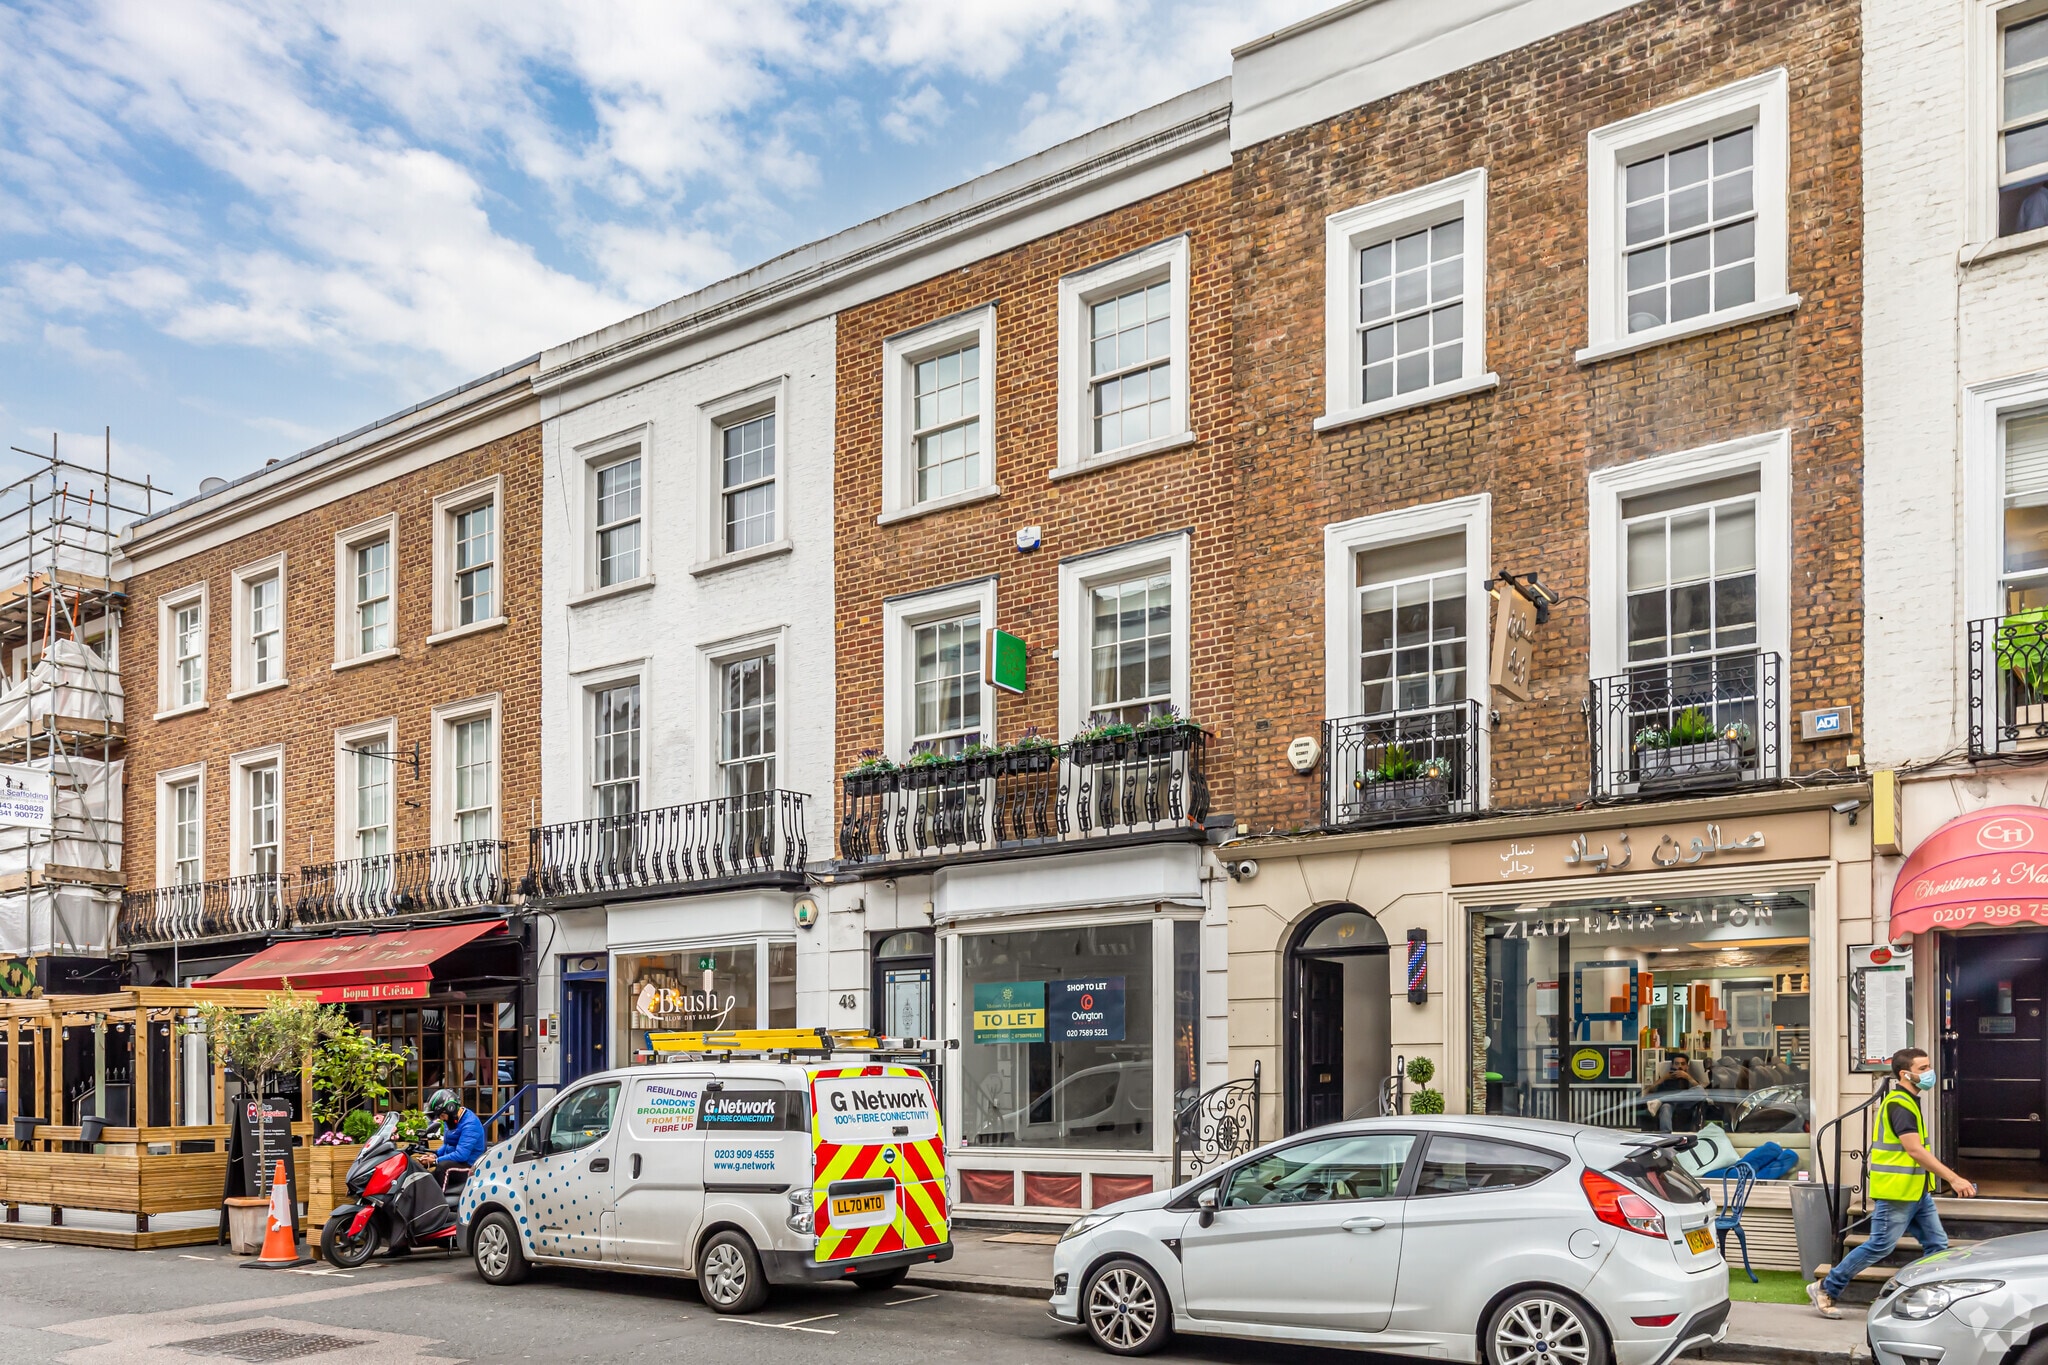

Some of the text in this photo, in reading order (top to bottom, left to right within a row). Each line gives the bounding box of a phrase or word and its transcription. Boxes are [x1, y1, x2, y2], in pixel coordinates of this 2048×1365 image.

[1816, 716, 1839, 731] ADT
[6, 789, 49, 800] Scaffolding
[14, 811, 44, 819] 900727
[1983, 825, 2023, 843] CH
[1500, 843, 1535, 861] نسائي
[1563, 823, 1767, 872] صالون زياد
[1500, 860, 1535, 878] رجالي
[1914, 868, 2001, 900] Christina's
[1933, 906, 1977, 923] 0207
[1983, 904, 2021, 918] 998
[1503, 906, 1774, 940] ZIAD HAIR SALON
[1337, 925, 1355, 938] 49
[1066, 982, 1107, 992] SHOP TO LET
[657, 985, 719, 1013] Brush
[838, 994, 857, 1010] 48
[982, 1012, 1037, 1027] TO LET
[1071, 1011, 1104, 1022] Ovington
[1066, 1029, 1078, 1037] 020
[1094, 1028, 1108, 1036] 5221
[646, 1085, 698, 1099] REBUILDING
[651, 1098, 696, 1107] LONDON'S
[830, 1089, 928, 1112] G Network
[636, 1107, 695, 1115] BROADBAND
[834, 1110, 929, 1125] 100% FIBRE CONNECTIVITY
[646, 1115, 694, 1125] FROM THE
[703, 1114, 717, 1122] 100%
[733, 1114, 775, 1123] CONNECTIVITY
[653, 1123, 694, 1133] FIBRE UP
[714, 1150, 775, 1159] 0203 909 4555
[713, 1161, 776, 1171] www.g.network
[837, 1196, 882, 1214] LL70 MTO
[1169, 1239, 1177, 1247] S
